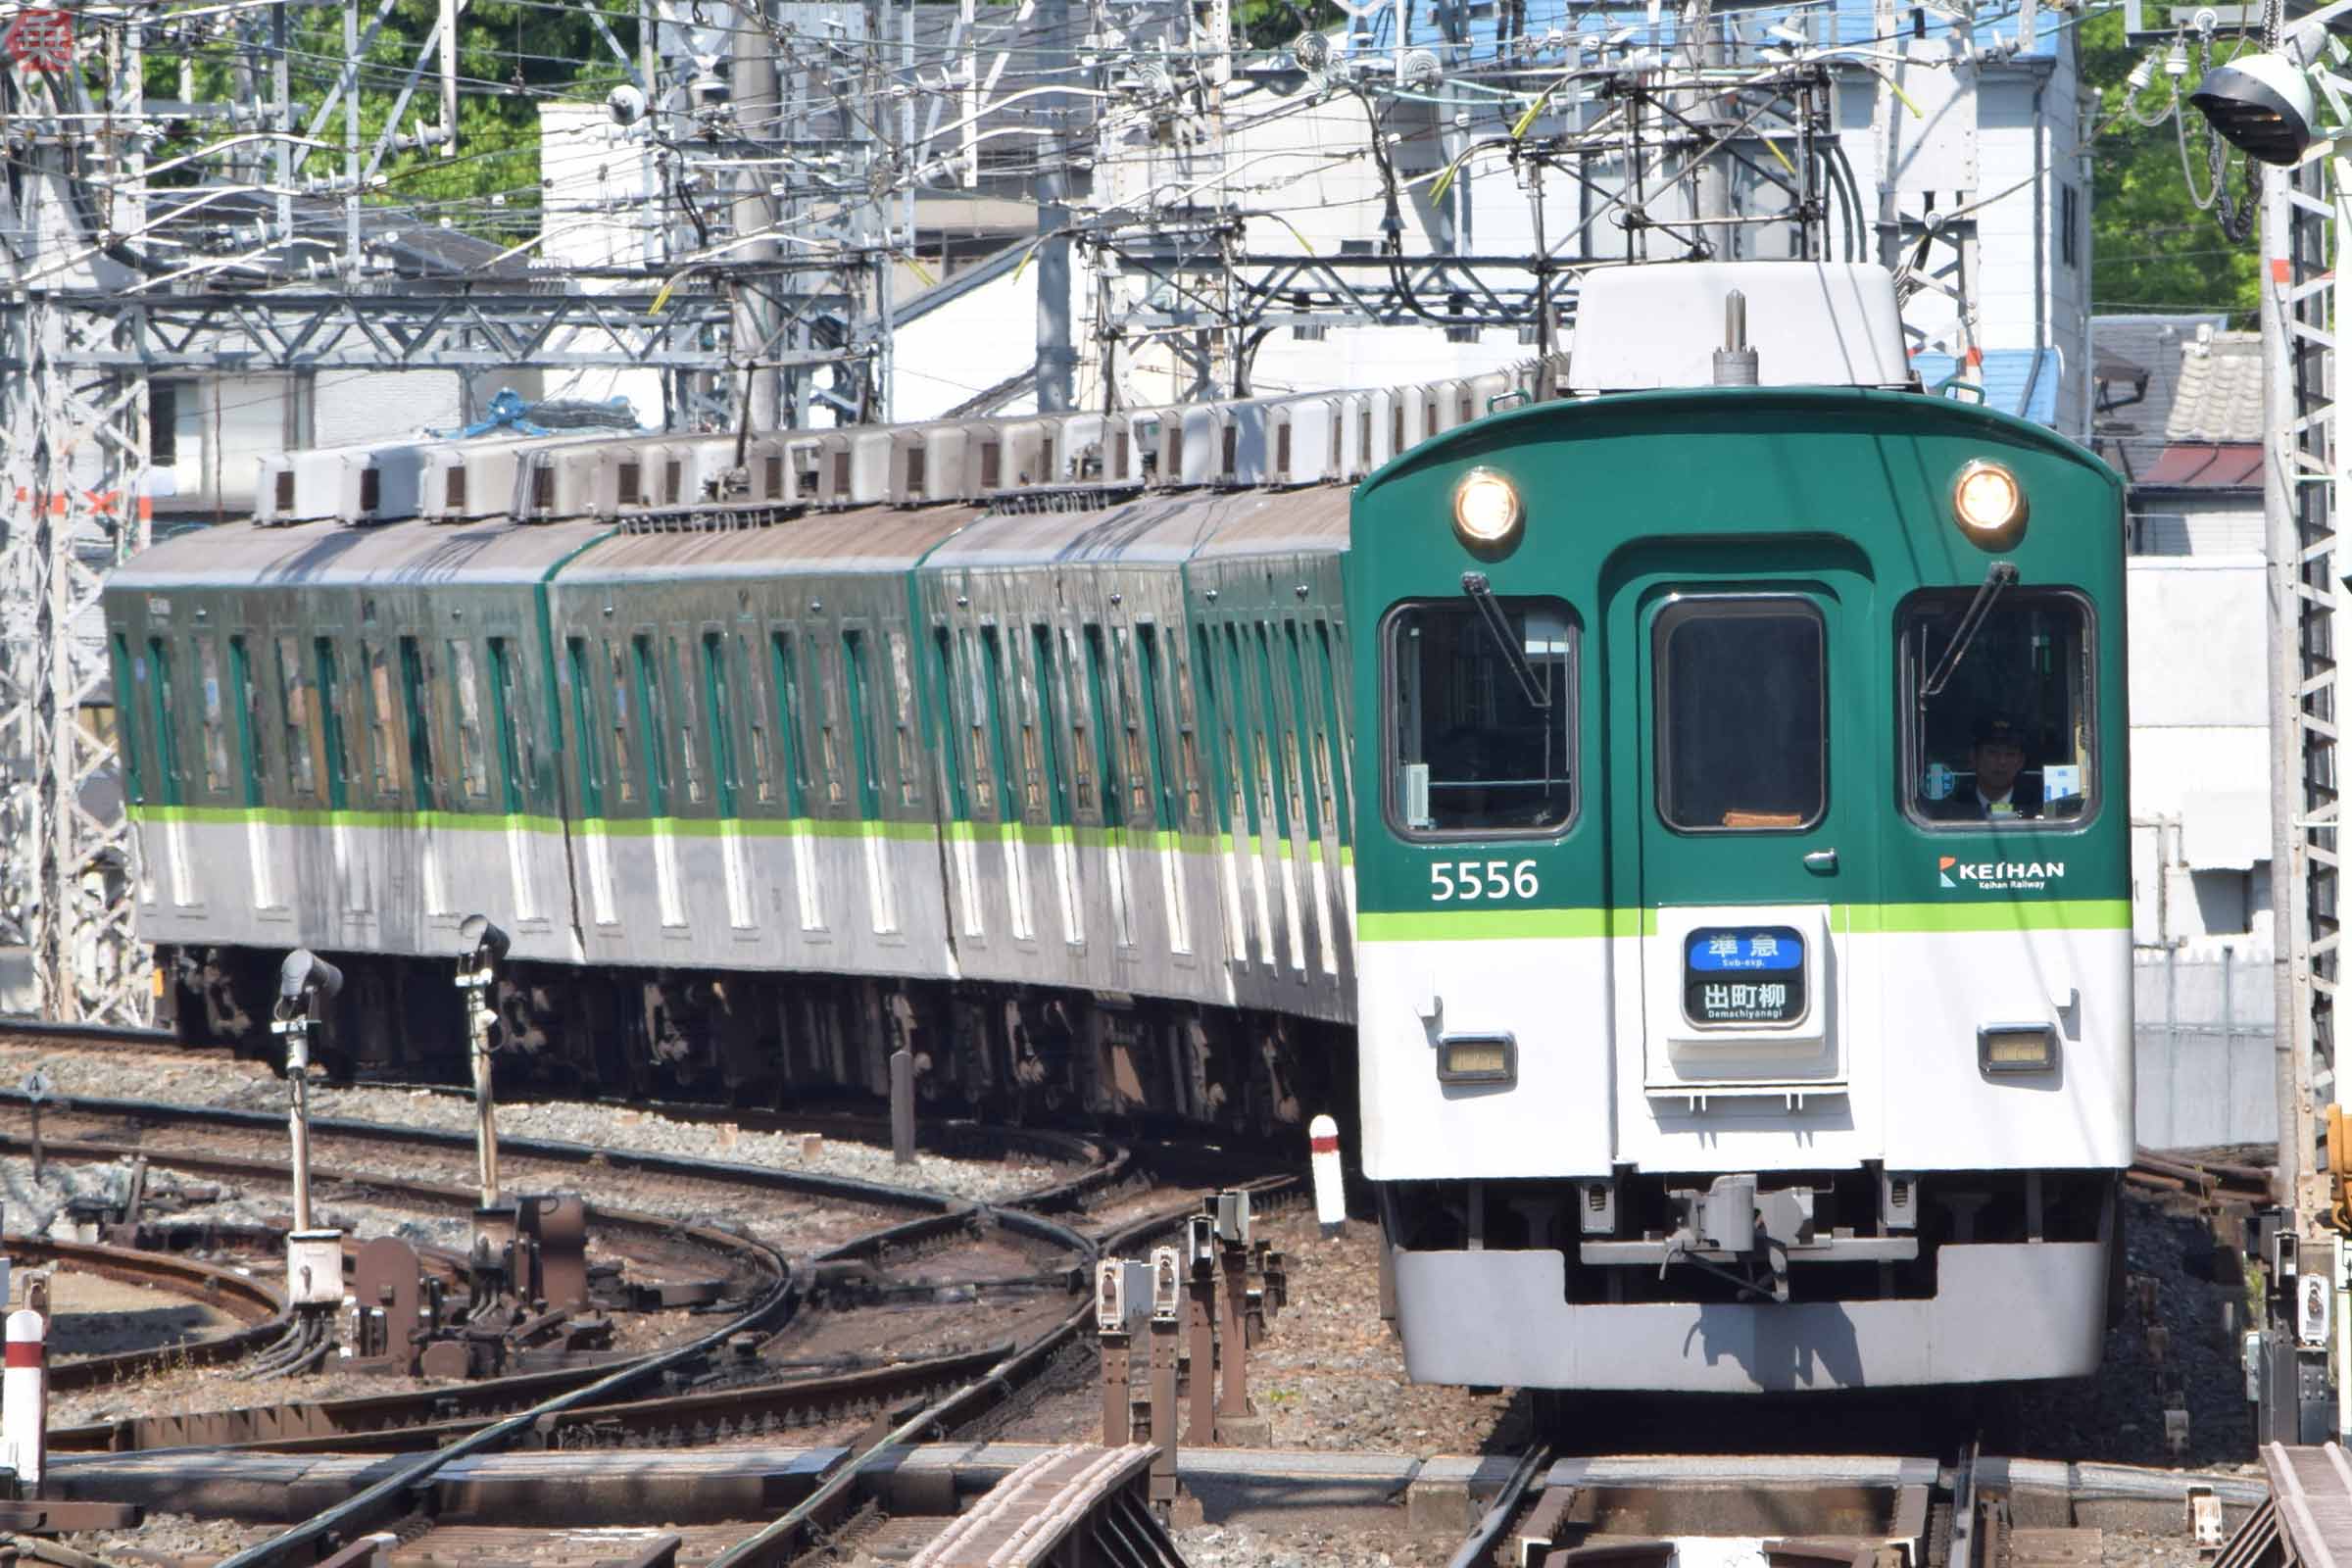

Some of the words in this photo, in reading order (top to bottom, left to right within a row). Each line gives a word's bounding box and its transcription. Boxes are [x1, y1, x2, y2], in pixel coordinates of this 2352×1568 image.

[1431, 858, 1539, 901] 5556
[1960, 861, 2064, 880] KEIHAN
[1979, 880, 2008, 889] Keihan
[2010, 880, 2045, 891] Railway
[1708, 934, 1779, 958] 準急
[1722, 958, 1765, 968] Sub-exp.
[1704, 983, 1786, 1009] 出町柳
[1708, 1008, 1783, 1019] Demachiyanagi
